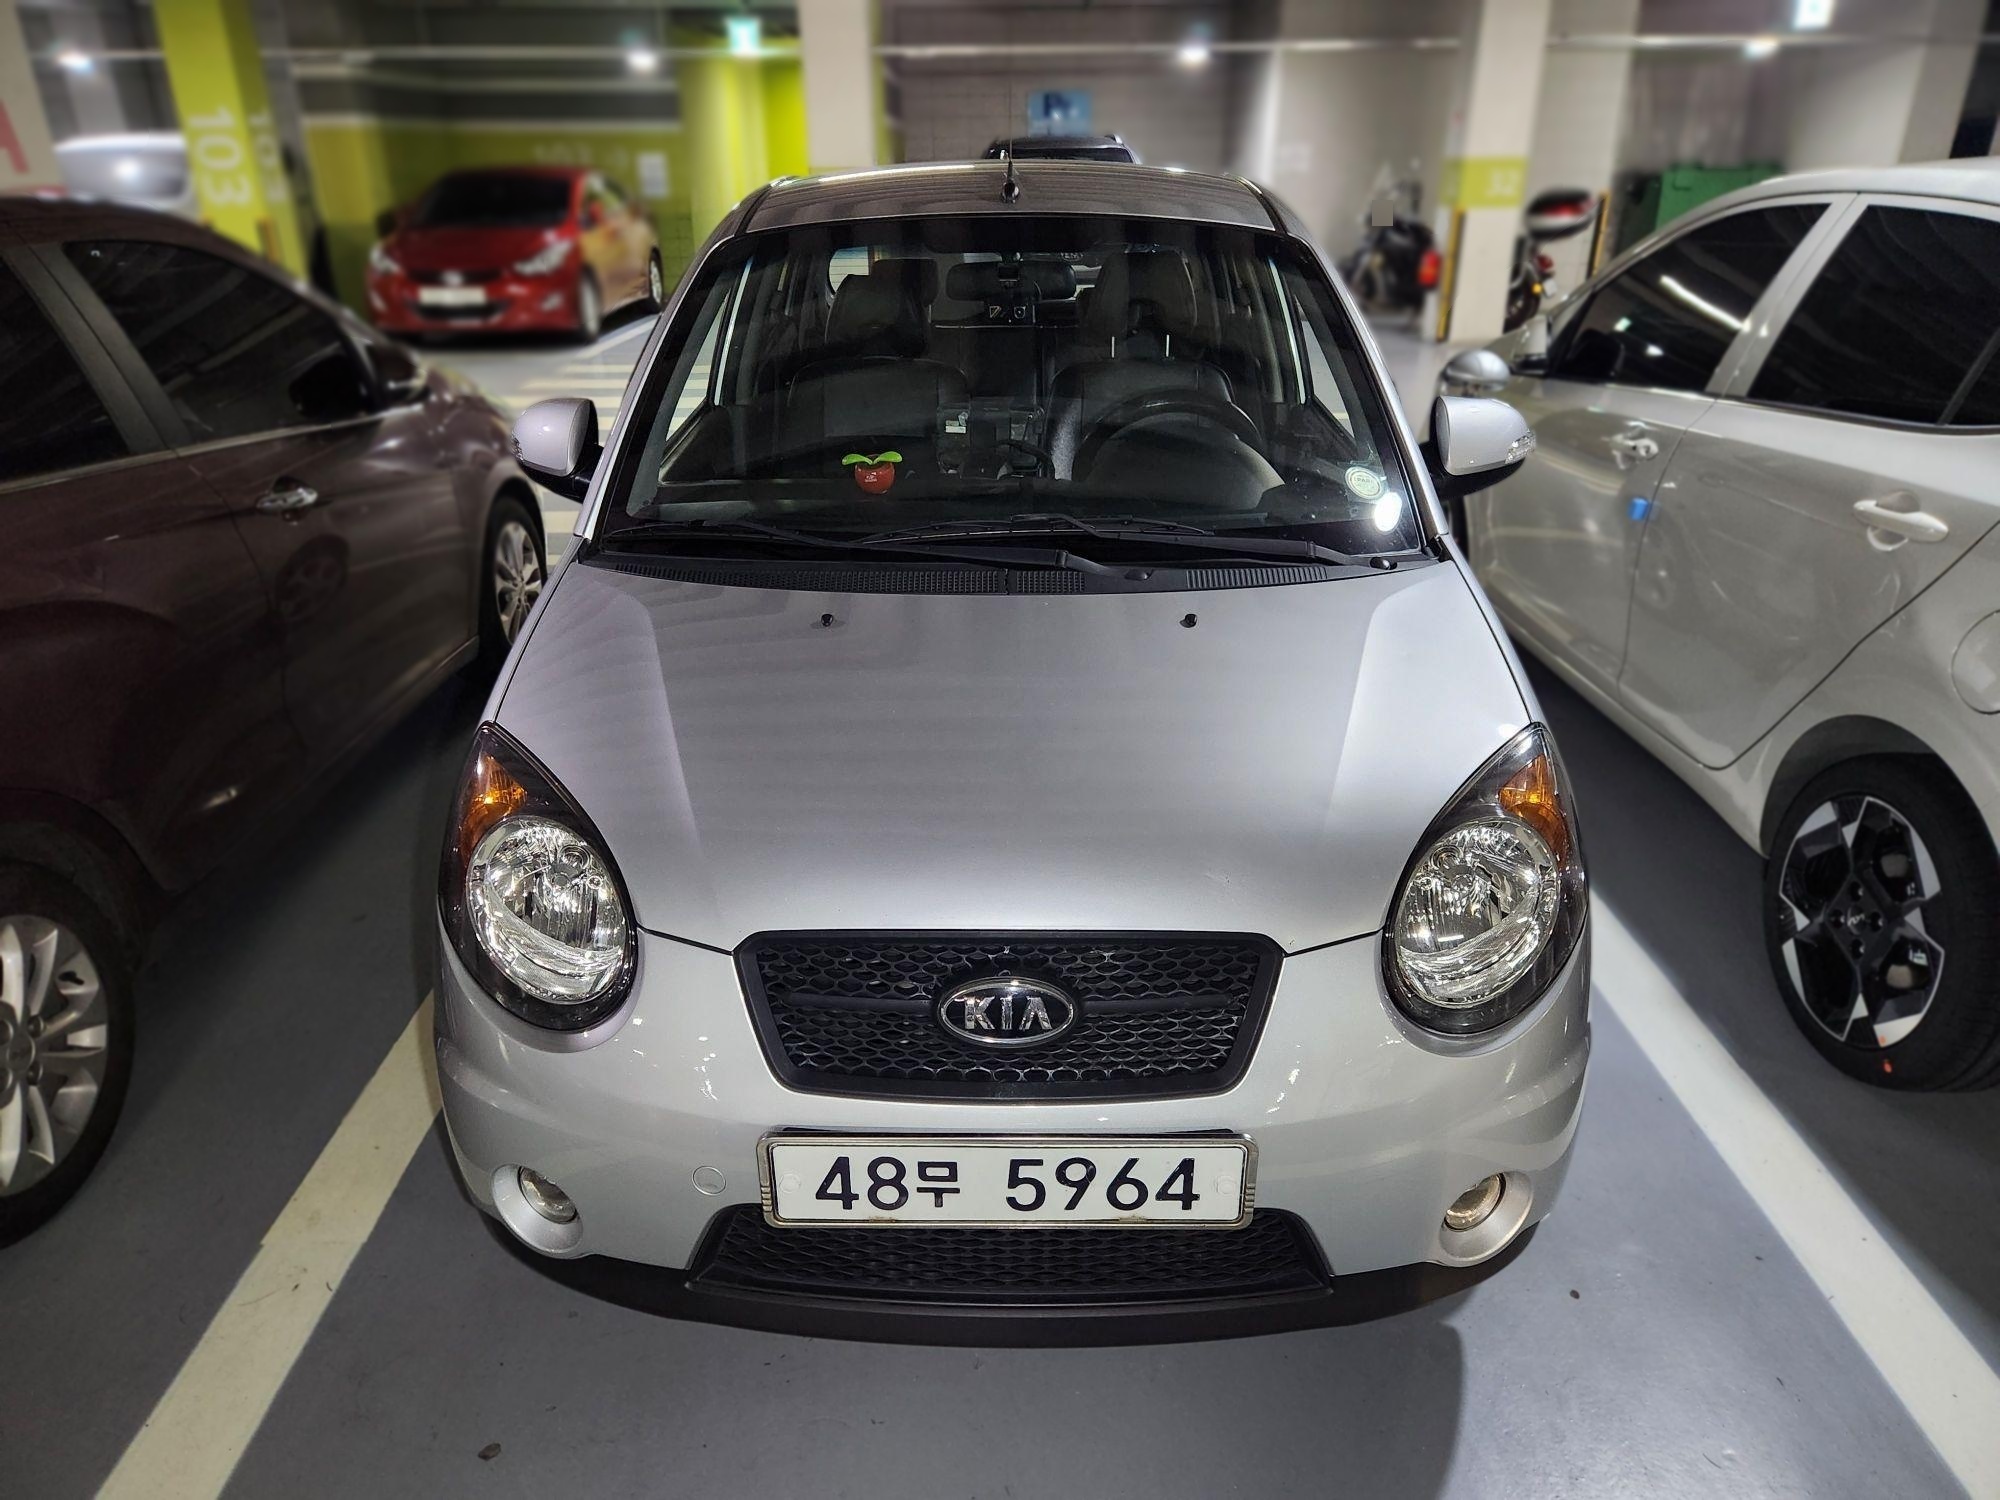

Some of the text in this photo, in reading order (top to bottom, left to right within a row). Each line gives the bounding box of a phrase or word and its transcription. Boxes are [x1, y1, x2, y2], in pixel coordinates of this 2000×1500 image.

[963, 995, 1053, 1031] KIA
[815, 1156, 1201, 1212] 48무 5964
